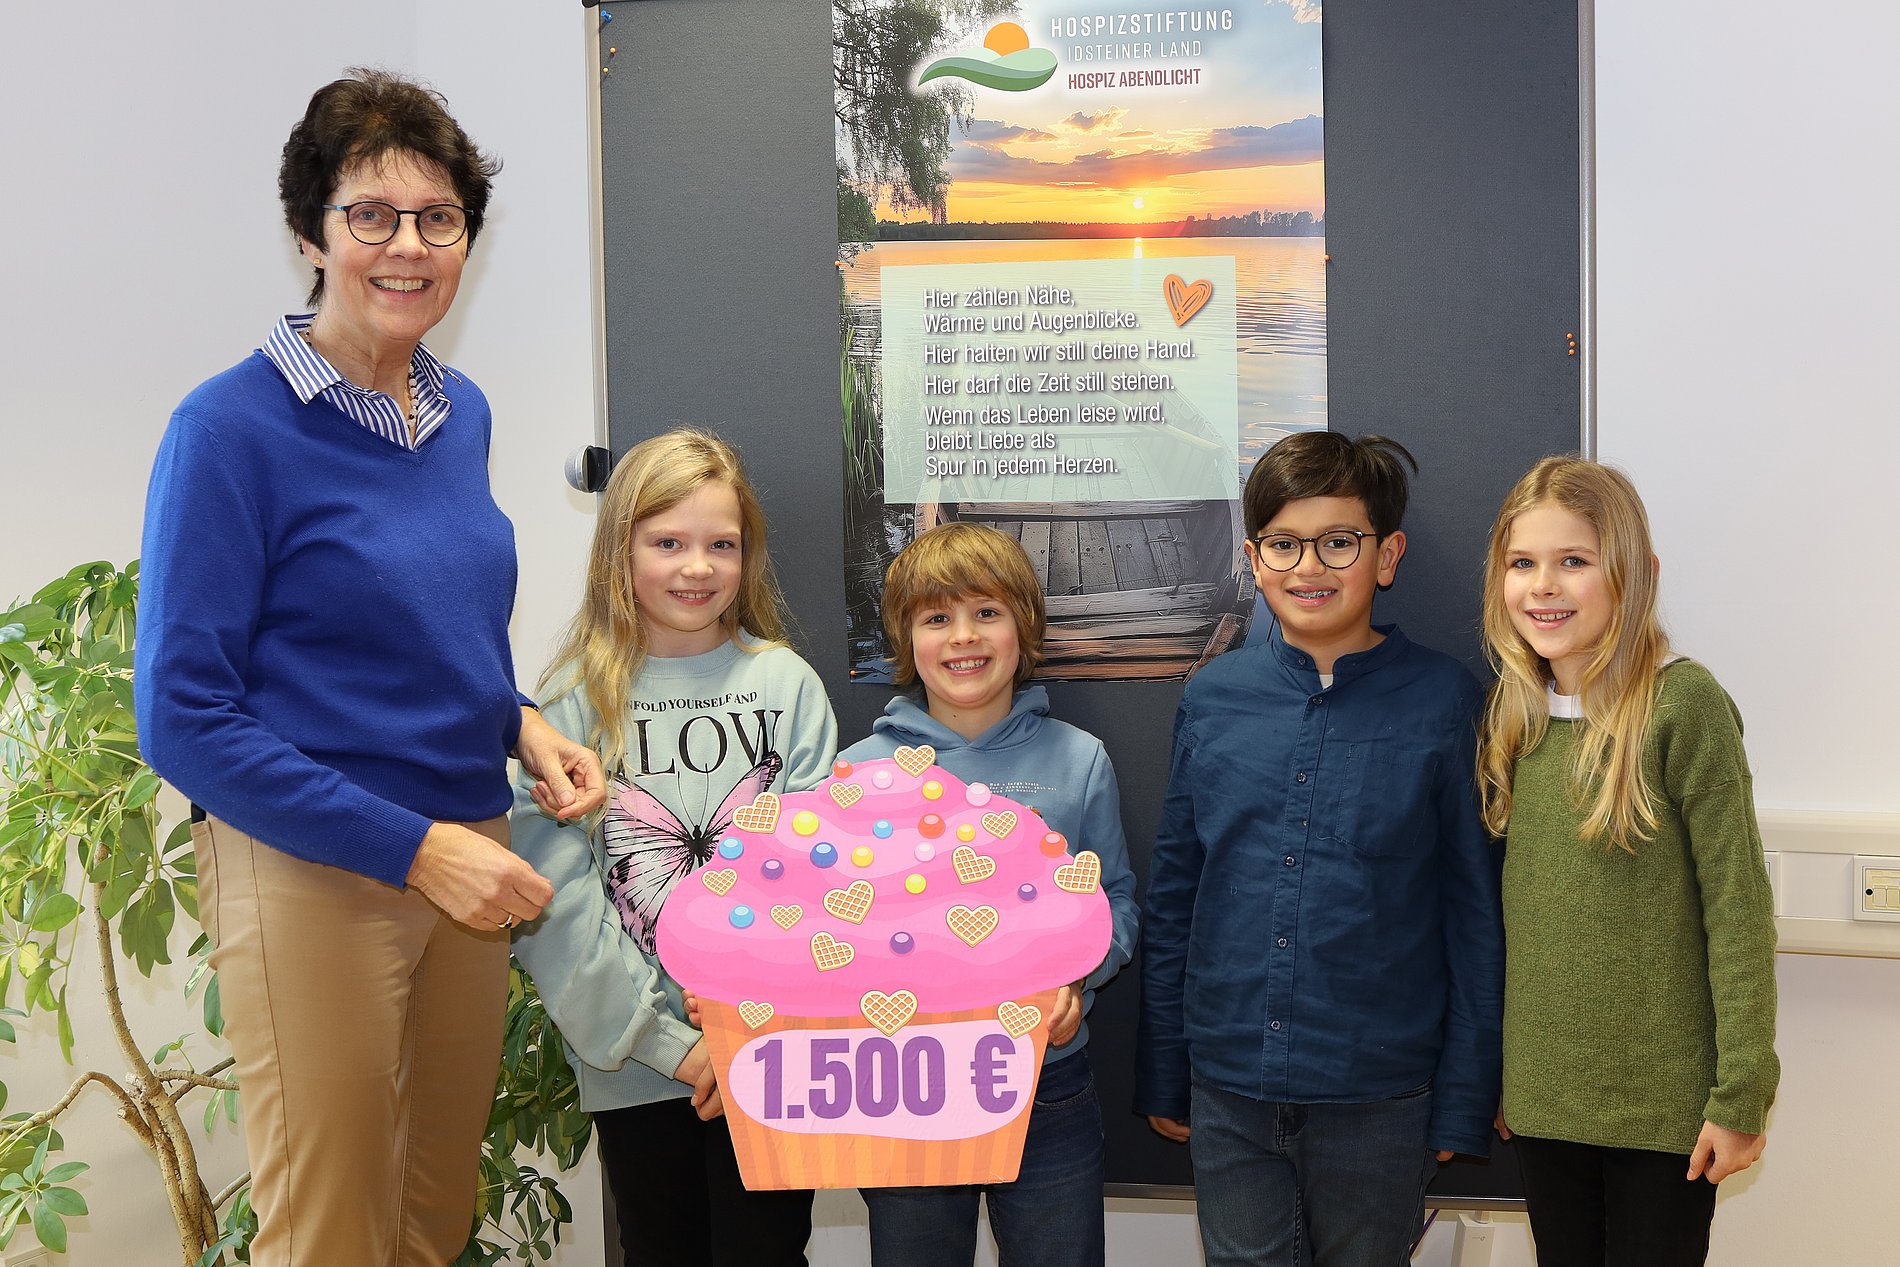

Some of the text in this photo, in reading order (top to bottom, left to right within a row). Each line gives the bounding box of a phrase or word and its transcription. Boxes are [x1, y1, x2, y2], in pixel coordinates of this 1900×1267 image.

[1051, 9, 1233, 38] HOSPIZSTIFTUNG
[1068, 40, 1201, 62] IDSTEINER LAND
[1068, 68, 1201, 90] HOSPIZ ABENDLICHT
[923, 284, 1075, 308] Hier zählen Nähe,
[923, 309, 1140, 335] Wärme und Augenblicke.
[924, 339, 1196, 364] Hier halten wir still deine Hand.
[924, 371, 1175, 395] Hier darf die Zeit still stehen.
[925, 402, 1165, 425] Wenn das Leben leise wird,
[925, 430, 1056, 451] bleibt Liebe als
[925, 454, 1119, 480] Spur in jedem Herzen.
[625, 691, 758, 712] NFOLD YOURSELF AND
[597, 709, 784, 777] LOW
[754, 1033, 1018, 1120] 1.500 €
